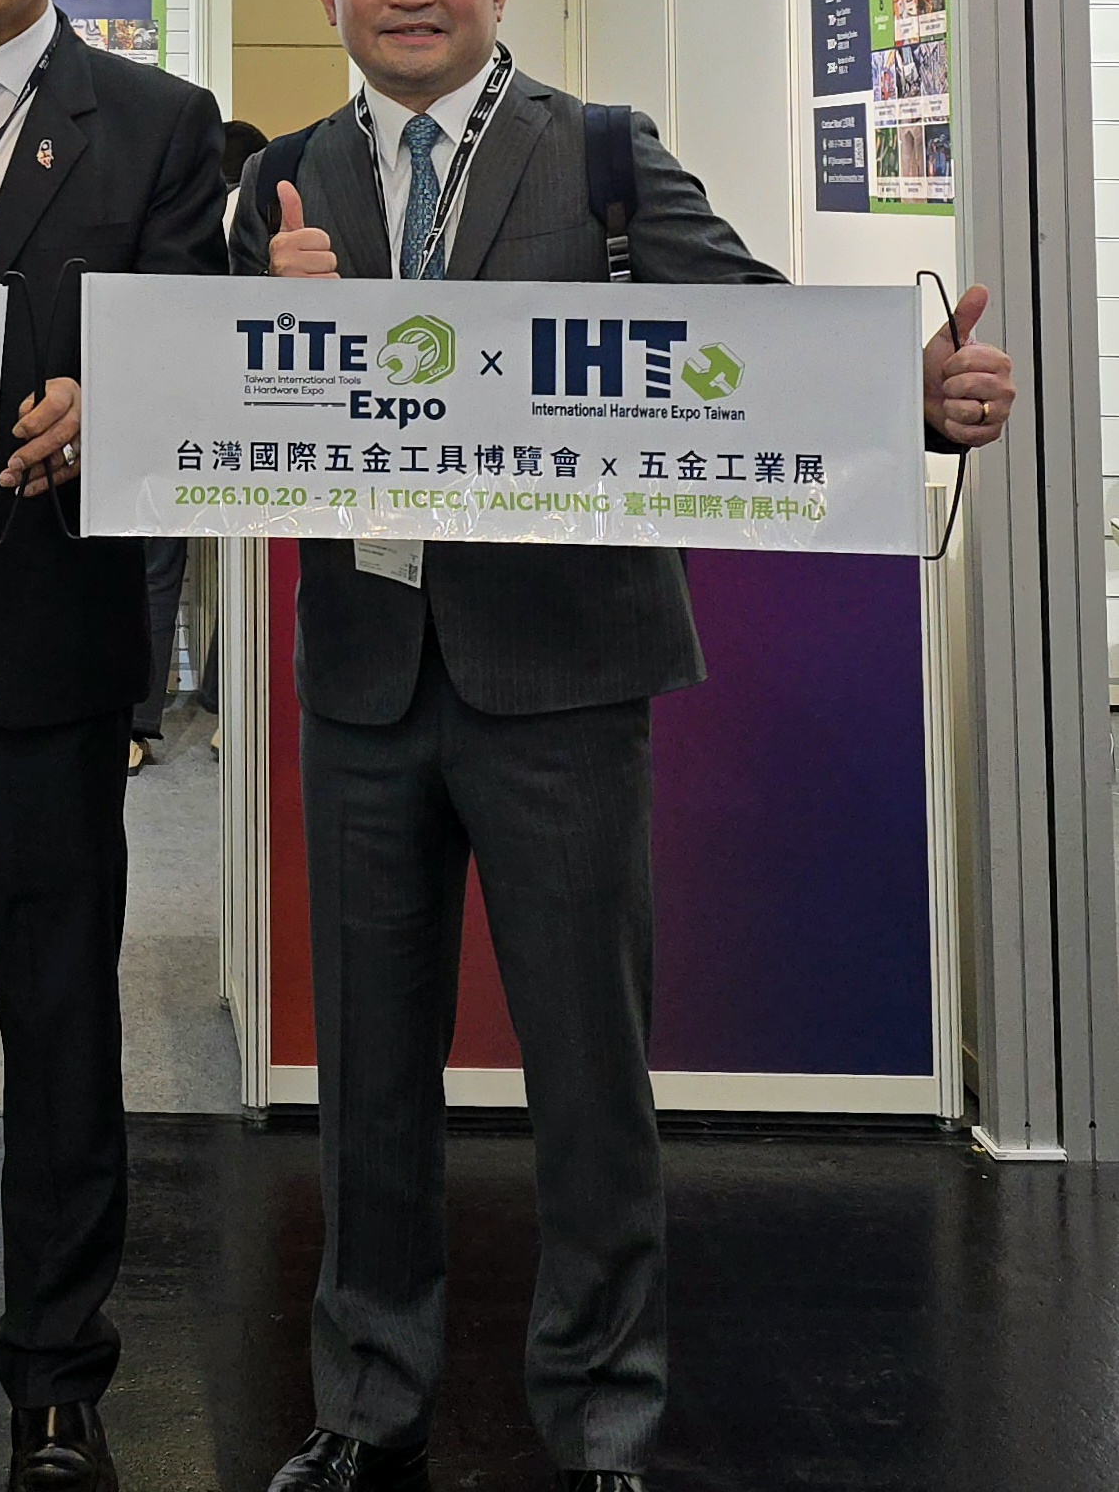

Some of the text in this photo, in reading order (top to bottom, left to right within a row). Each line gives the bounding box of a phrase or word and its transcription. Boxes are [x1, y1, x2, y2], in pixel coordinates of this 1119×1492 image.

[237, 312, 368, 371] TiTE
[532, 317, 688, 399] IHT
[244, 374, 362, 386] Taiwan International Tools
[253, 384, 299, 395] Hardware
[301, 386, 325, 396] Expo
[350, 390, 447, 430] Expo
[532, 401, 746, 422] International Hardware Expo Taiwan
[638, 450, 827, 485] 五金工業展
[174, 485, 308, 508] 2026.10.20
[328, 487, 359, 508] 22
[473, 489, 611, 513] TAICHUNG
[623, 491, 828, 522] 臺中國際會展中心
